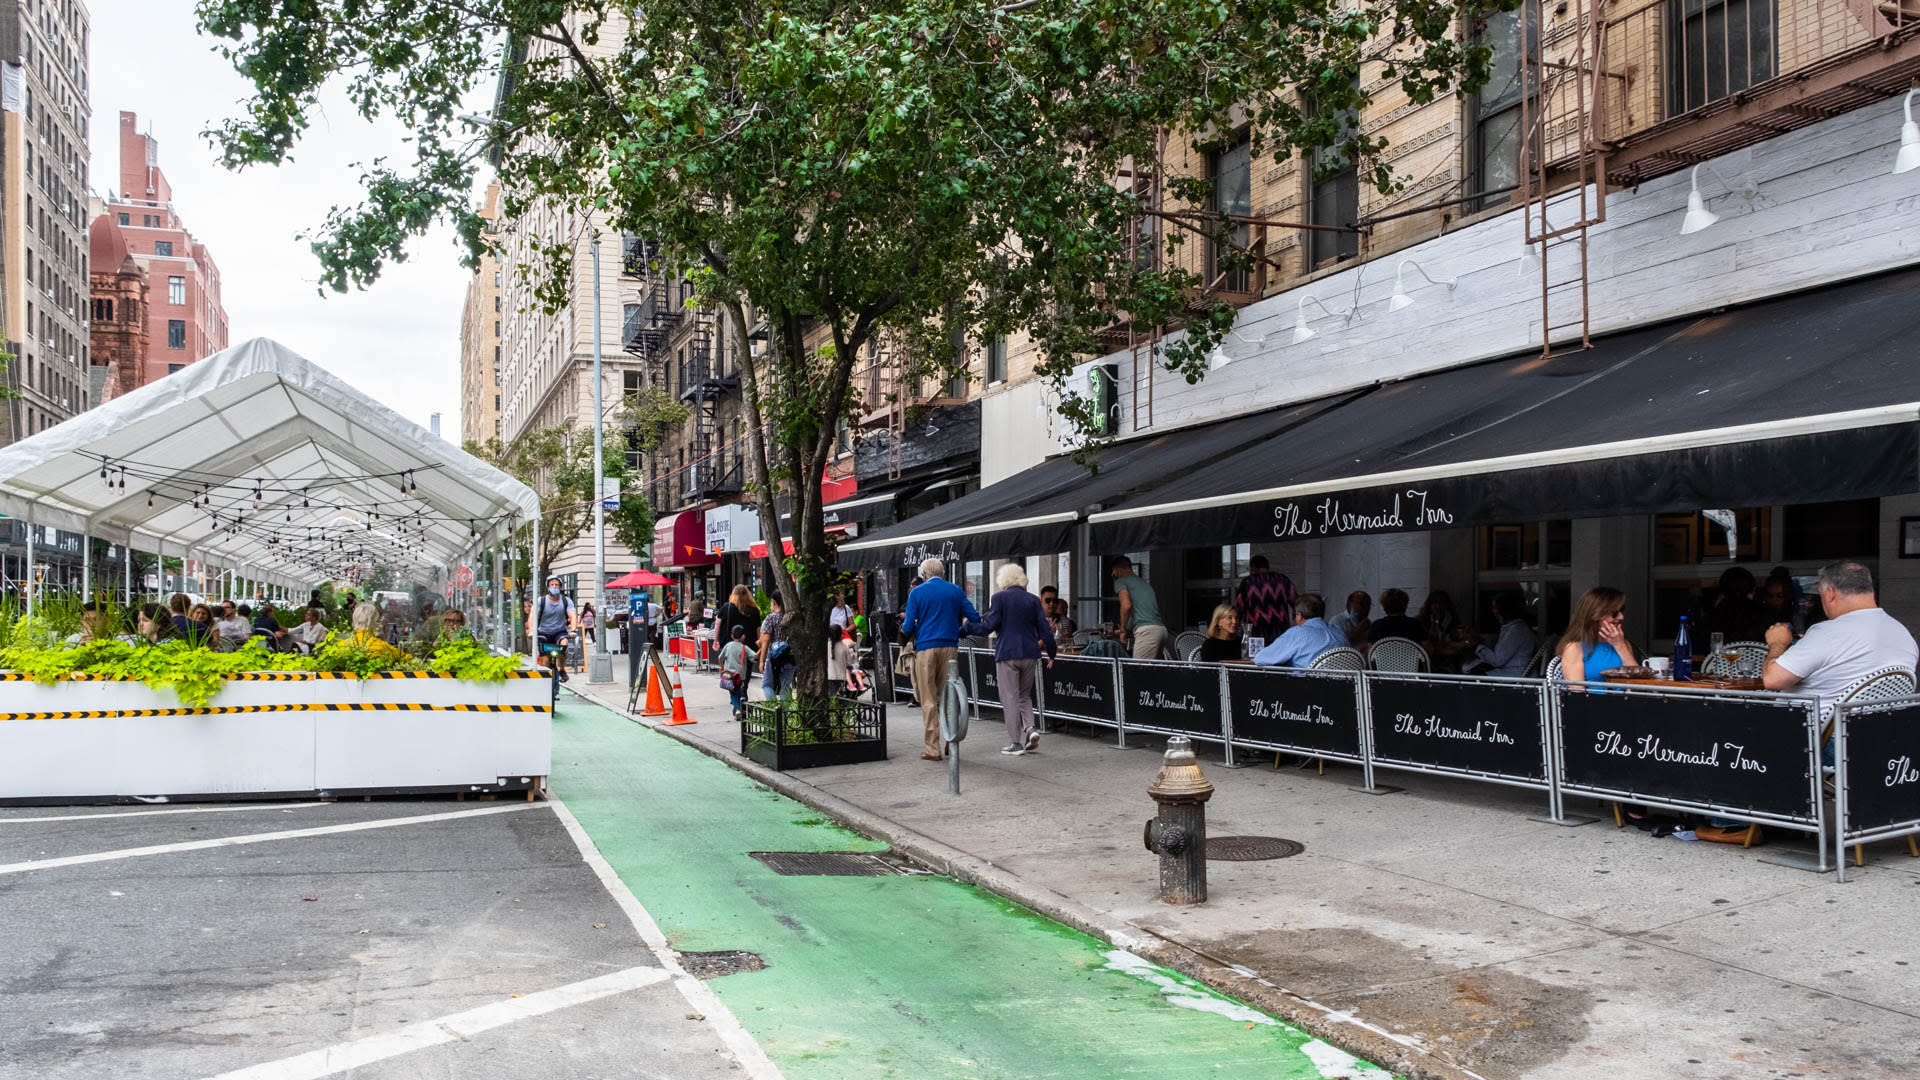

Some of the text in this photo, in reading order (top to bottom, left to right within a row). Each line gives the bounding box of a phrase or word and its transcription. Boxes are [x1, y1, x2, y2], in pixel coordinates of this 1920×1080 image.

[1273, 489, 1454, 537] The Mermaid Inn
[903, 545, 917, 566] The
[946, 540, 960, 561] Inn
[635, 601, 643, 611] P
[1054, 680, 1103, 702] The Mermaid Inn
[1138, 690, 1205, 713] The Mermaid Inn
[1249, 698, 1335, 727] The Mermaid Inn
[1394, 713, 1515, 746] The Mermaid Inn
[1594, 730, 1768, 774] The Mermaid Inn
[1884, 755, 1919, 787] The
